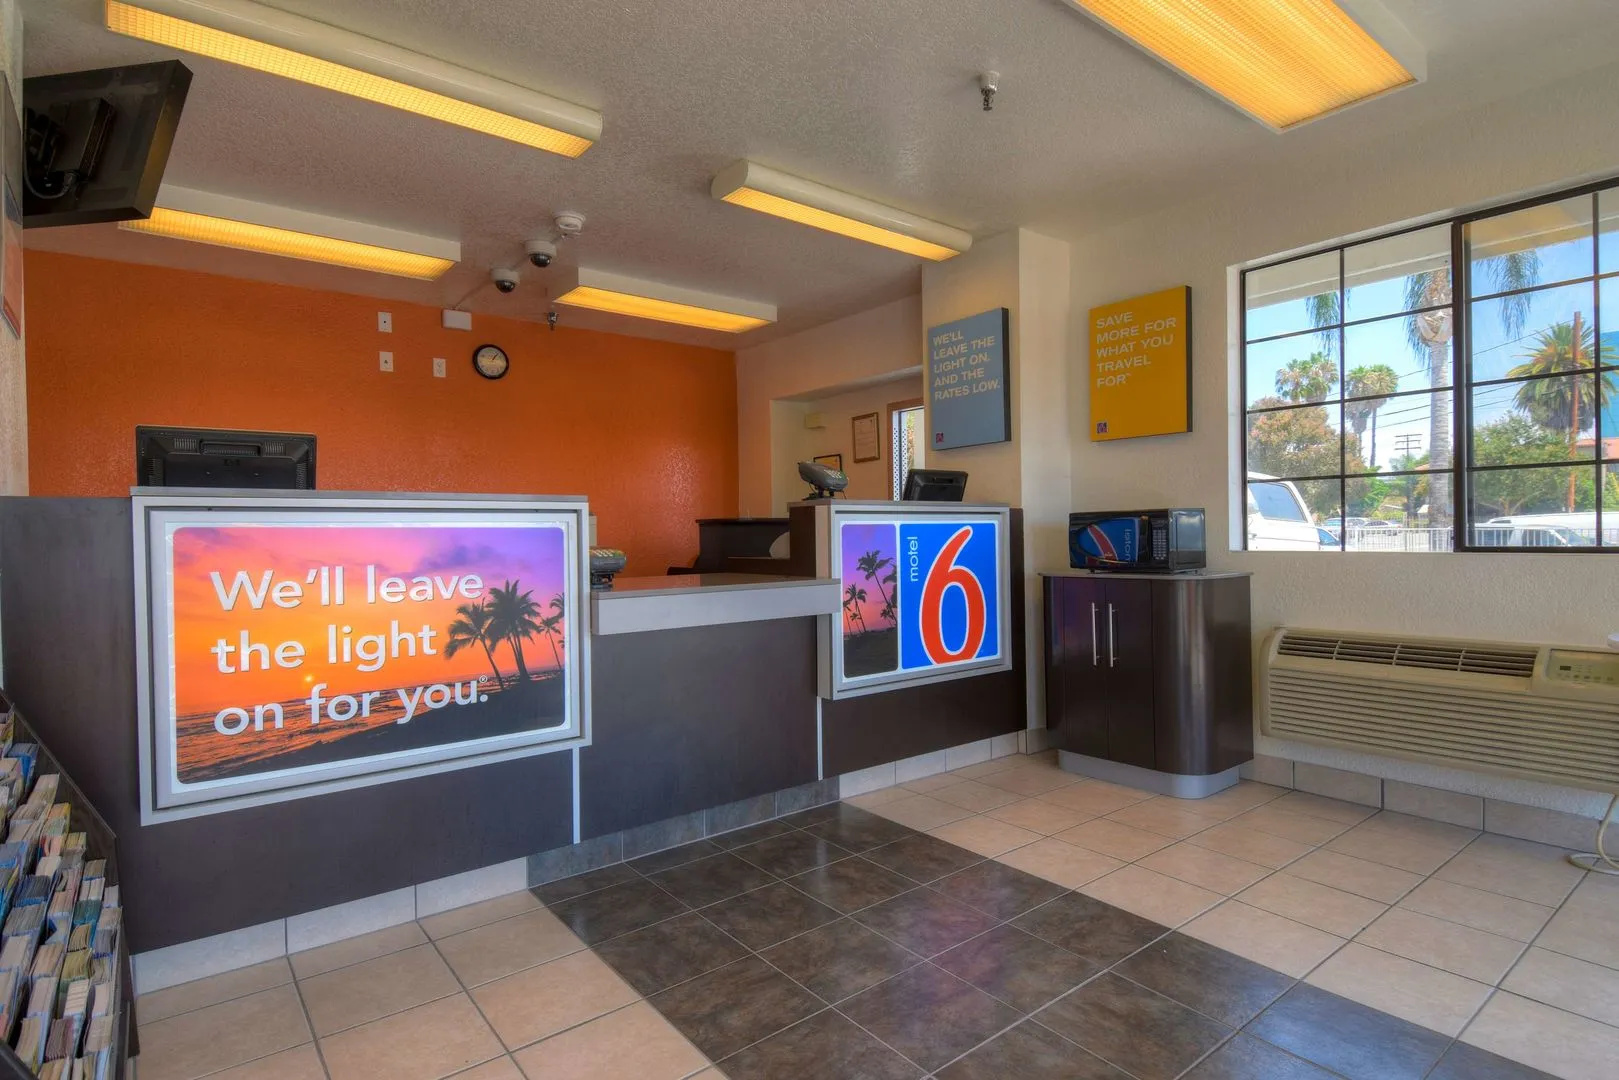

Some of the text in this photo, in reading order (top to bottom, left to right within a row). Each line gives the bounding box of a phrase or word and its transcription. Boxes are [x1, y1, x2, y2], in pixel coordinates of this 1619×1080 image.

[1096, 311, 1133, 329] SAVE
[1096, 316, 1177, 344] MORE FOR
[932, 330, 964, 347] WE'LL
[933, 335, 996, 360] LEAVE THE
[1096, 333, 1174, 358] WHAT YOU
[934, 356, 967, 373] LIGHT
[1096, 354, 1151, 373] TRAVEL
[934, 367, 985, 388] AND THE
[934, 385, 969, 401] RATES
[209, 564, 484, 612] We'll leave
[907, 525, 987, 665] motel 6
[211, 620, 437, 674] the light
[214, 702, 284, 736] on
[305, 683, 381, 725] for
